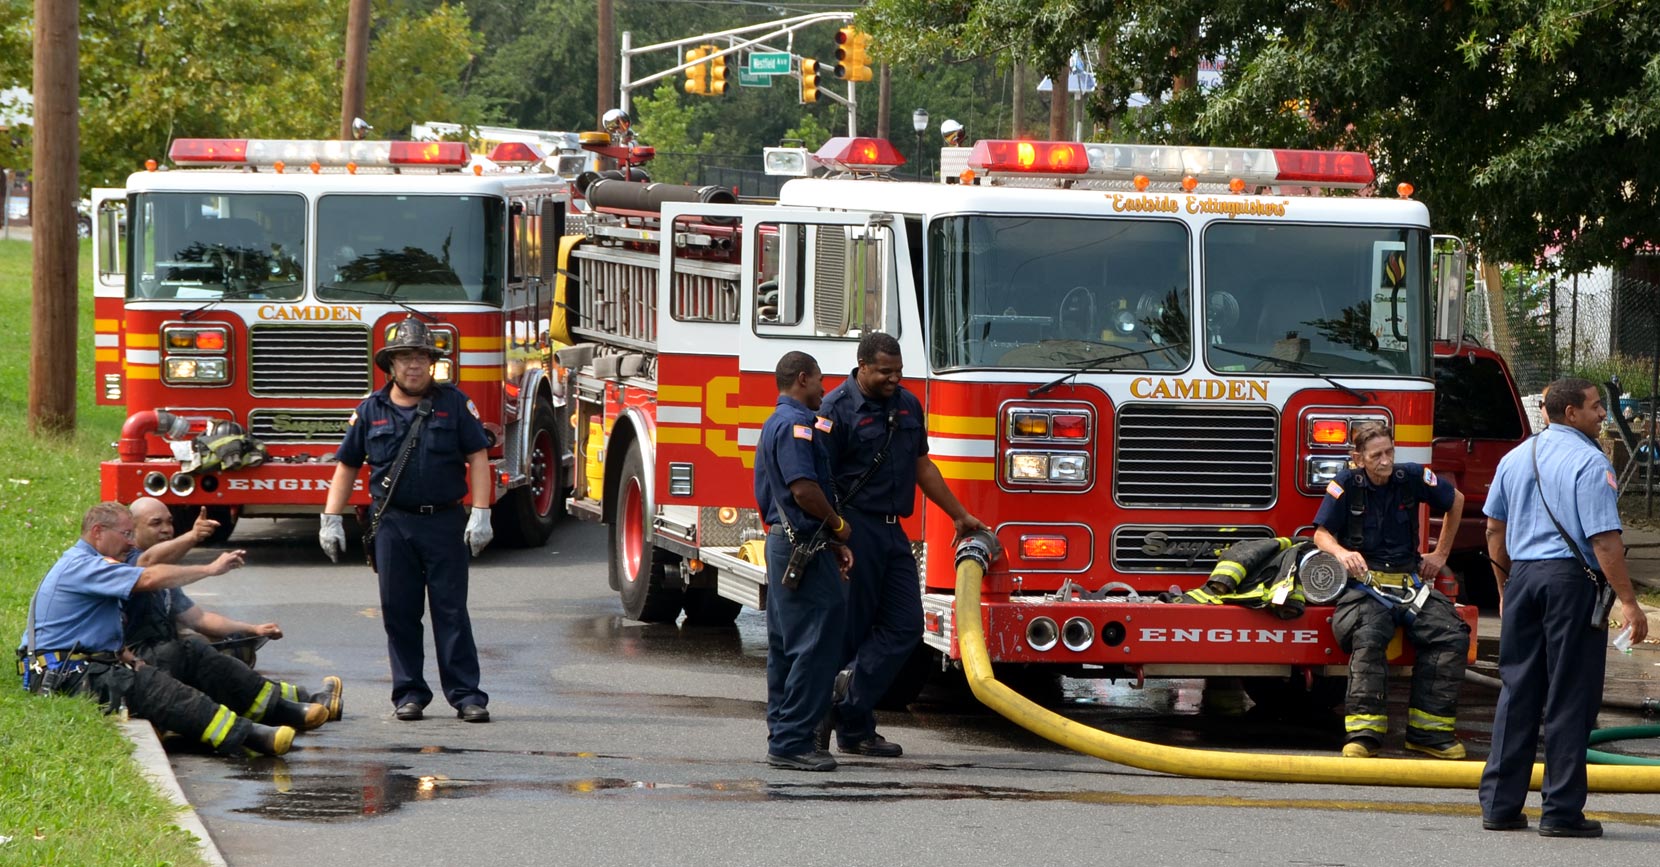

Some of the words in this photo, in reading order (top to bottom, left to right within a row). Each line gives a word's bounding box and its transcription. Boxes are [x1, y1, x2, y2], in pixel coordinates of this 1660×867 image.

[257, 305, 363, 321] CAMDEN
[1129, 377, 1270, 401] CAMDEN
[1138, 628, 1319, 644] ENGINE
